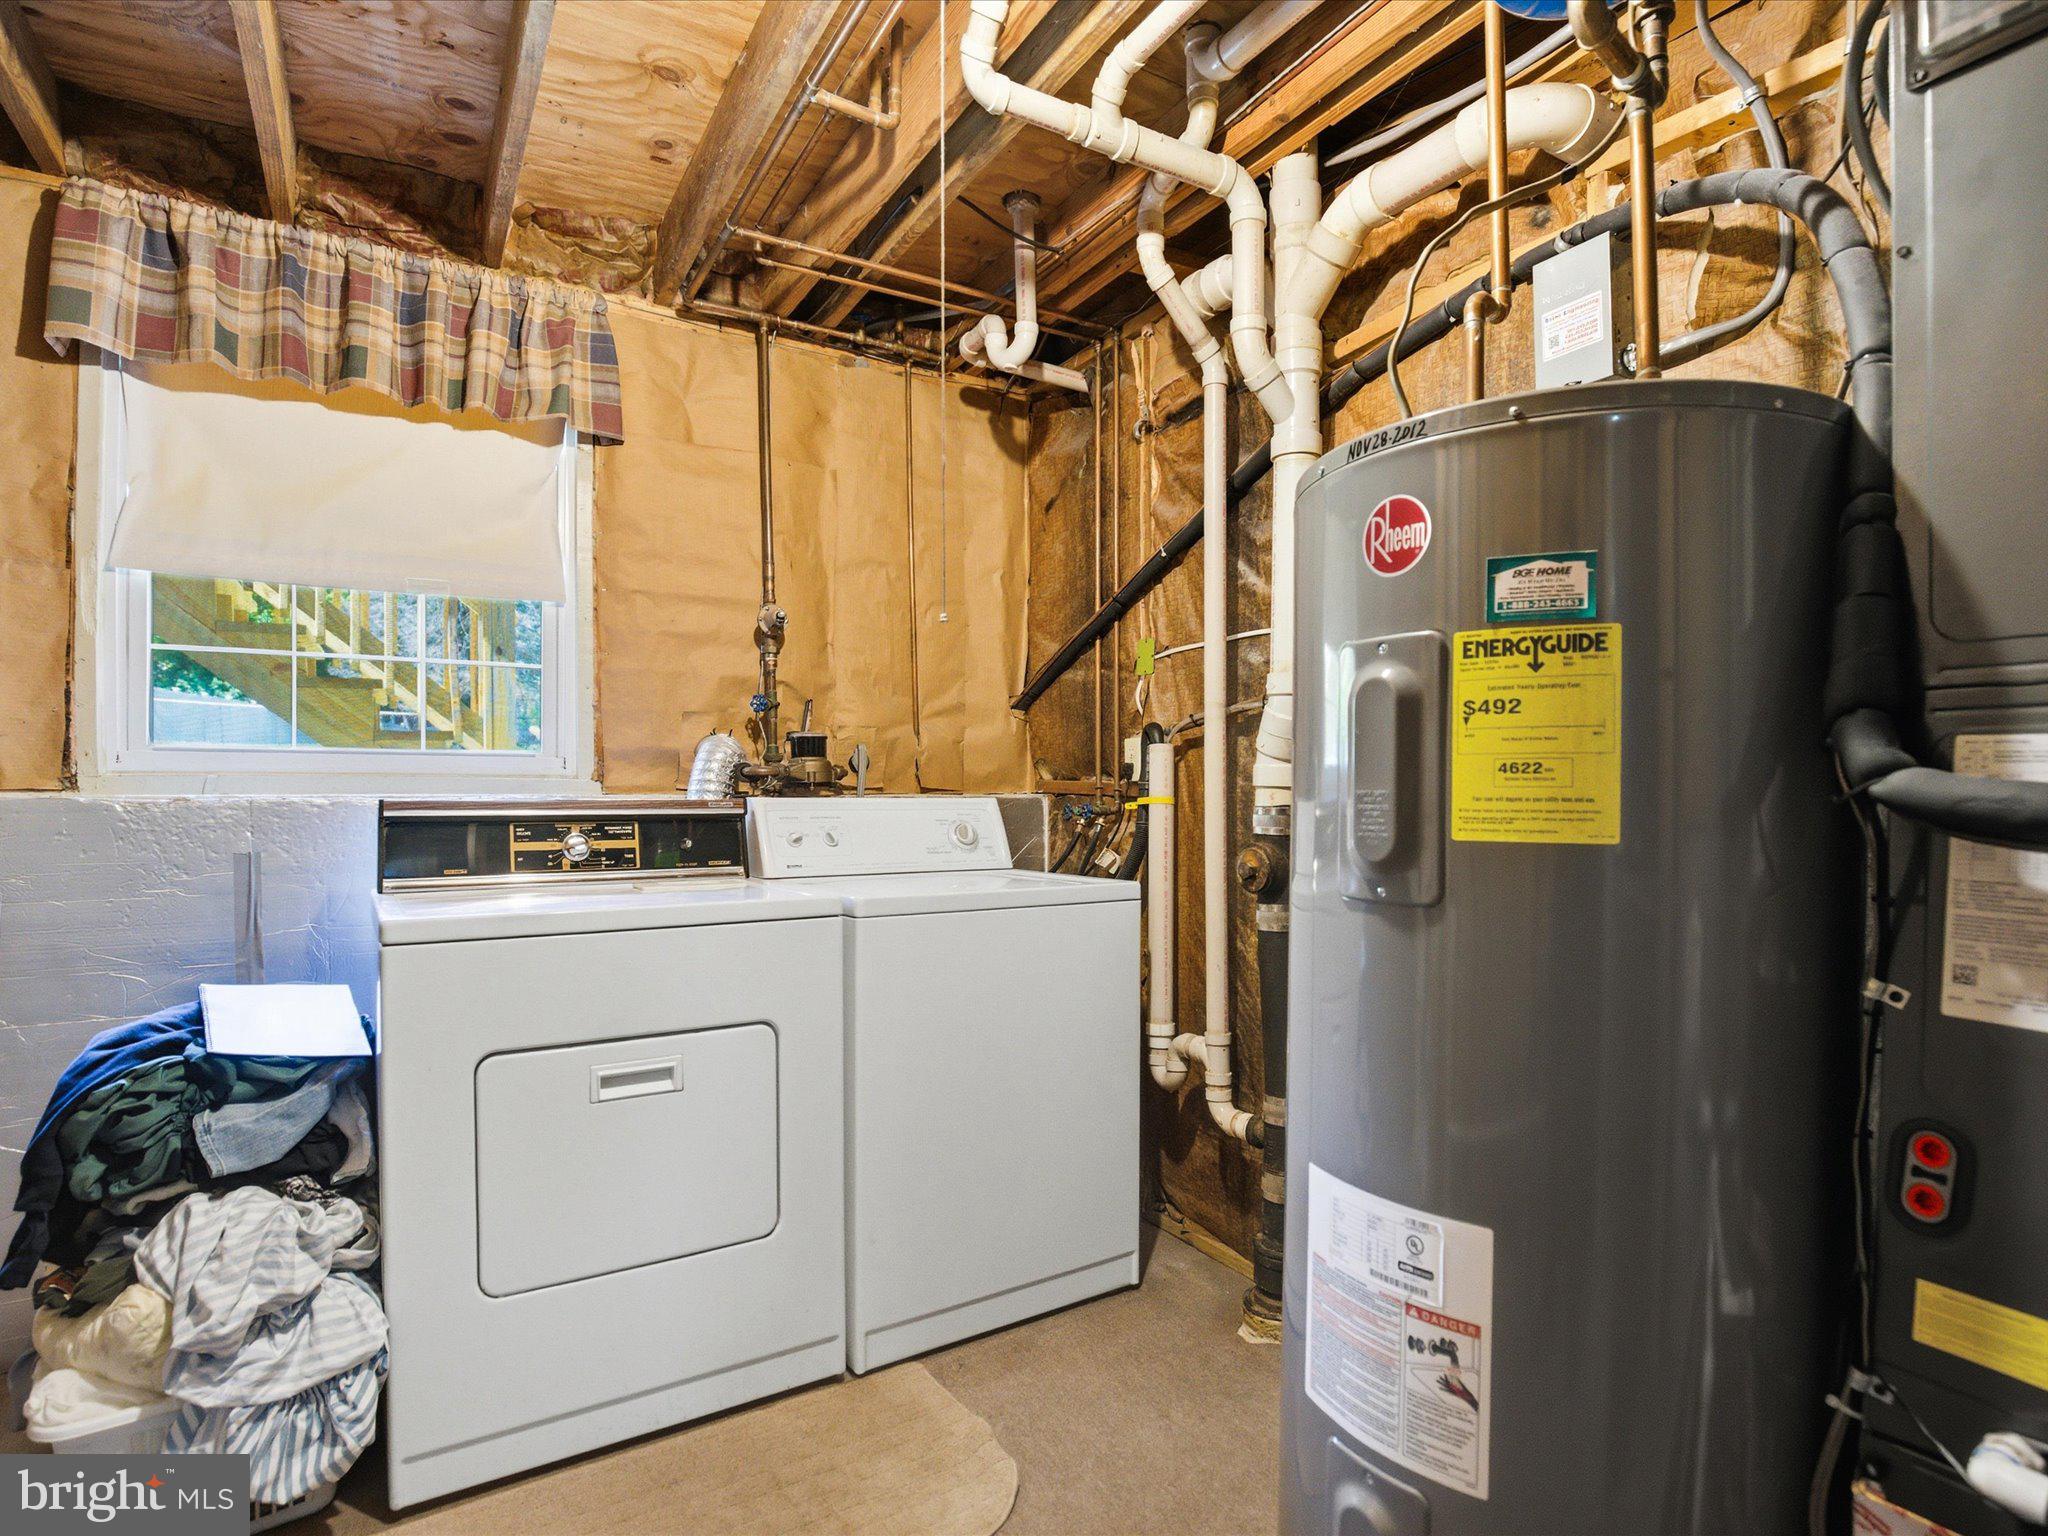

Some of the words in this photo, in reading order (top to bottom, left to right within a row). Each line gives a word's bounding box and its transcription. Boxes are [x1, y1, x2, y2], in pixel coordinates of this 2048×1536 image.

[1370, 500, 1424, 565] Rheem
[1512, 568, 1535, 579] BGE
[1536, 565, 1572, 577] HOME
[1462, 697, 1522, 716] $492
[1497, 761, 1544, 775] 4622
[1422, 1310, 1478, 1337] DANGER
